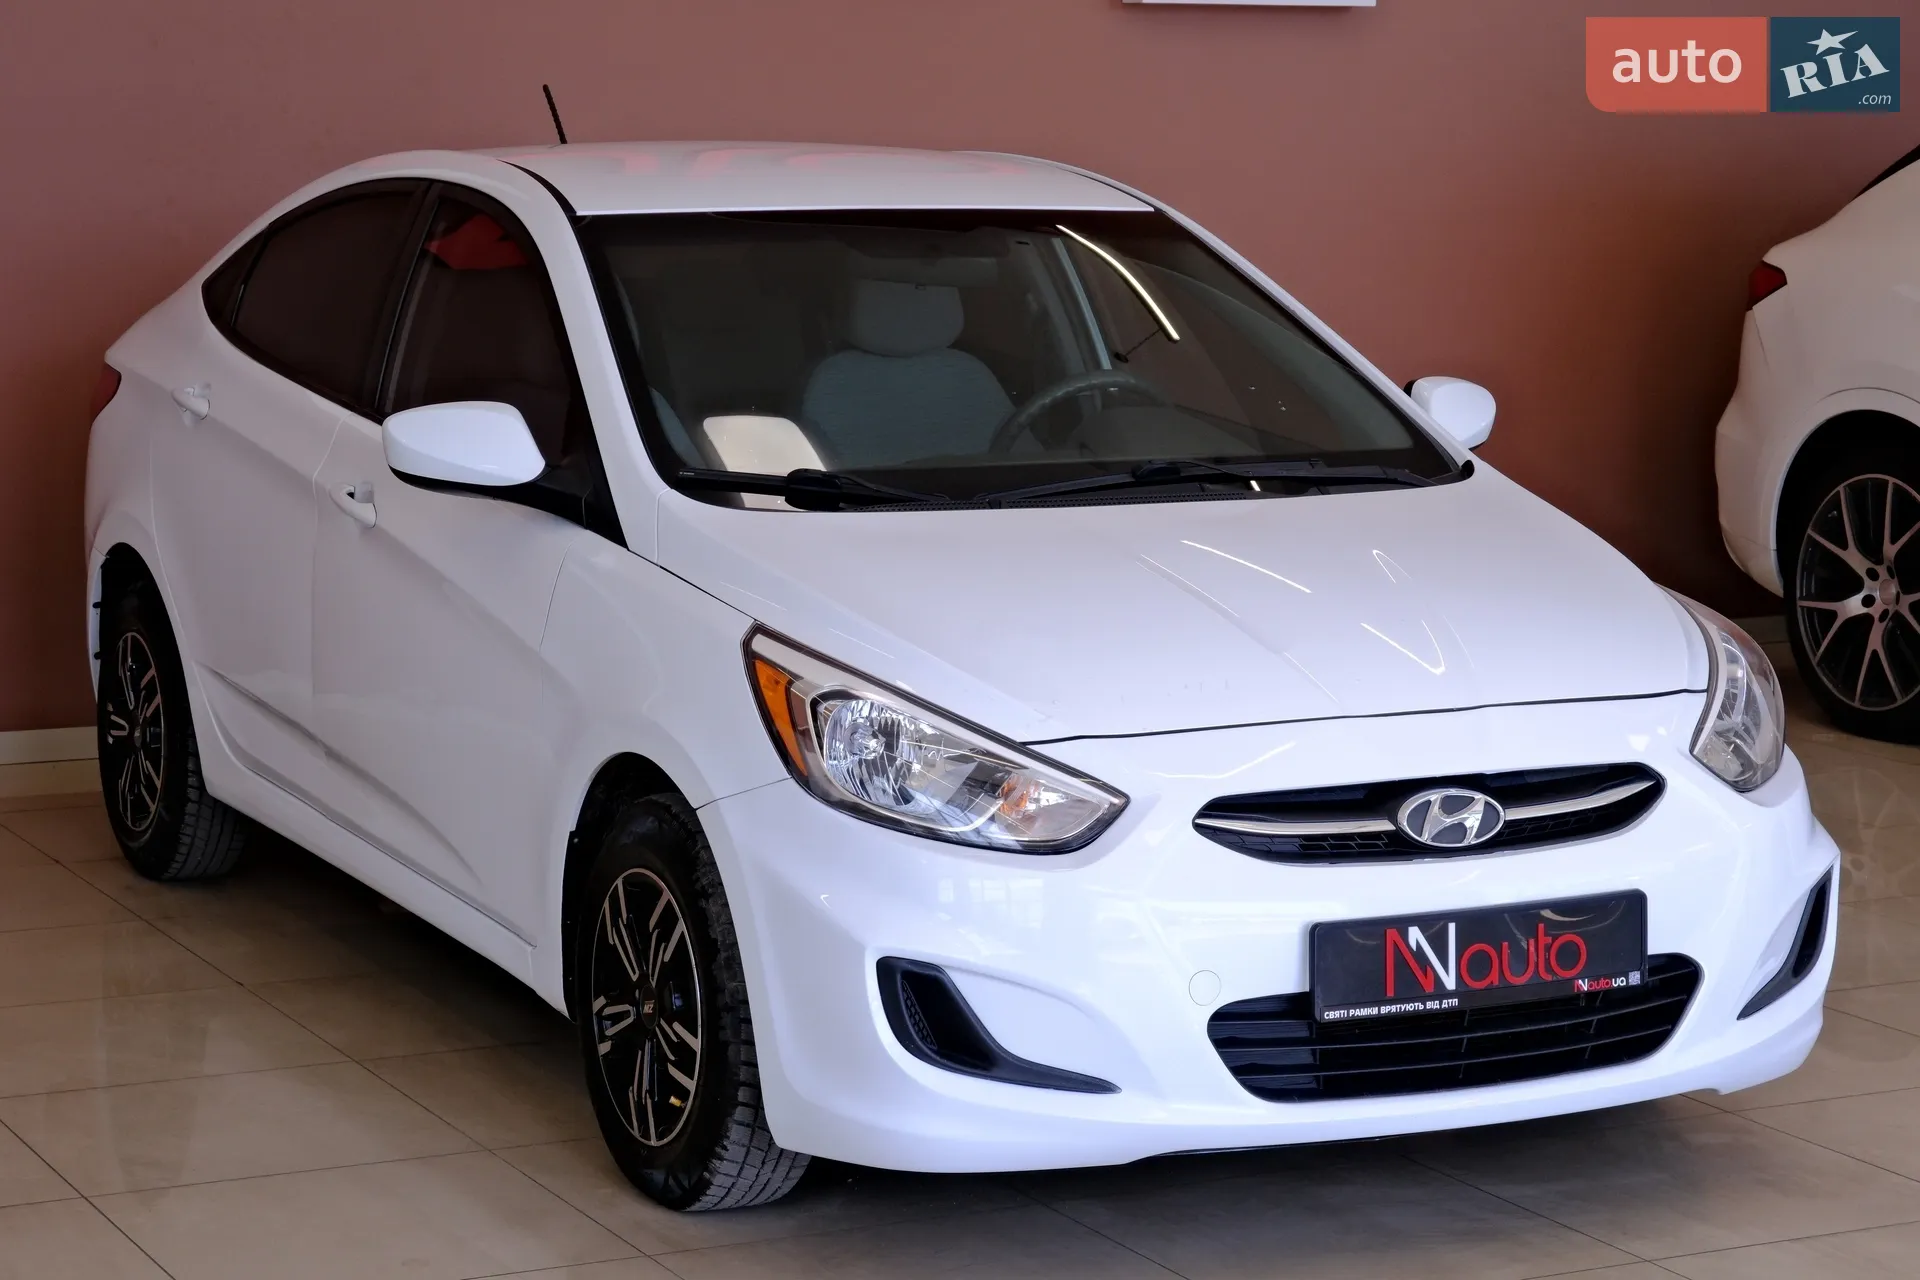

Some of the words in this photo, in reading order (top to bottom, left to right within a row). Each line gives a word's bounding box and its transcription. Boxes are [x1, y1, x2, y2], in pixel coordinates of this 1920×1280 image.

[1324, 1010, 1348, 1020] СВЯТІ
[1349, 1007, 1379, 1017] РАМКИ
[1380, 1003, 1425, 1014] ВРЯТУЮТЬ
[1426, 1000, 1440, 1009] ВІД
[1441, 998, 1459, 1009] ДТП
